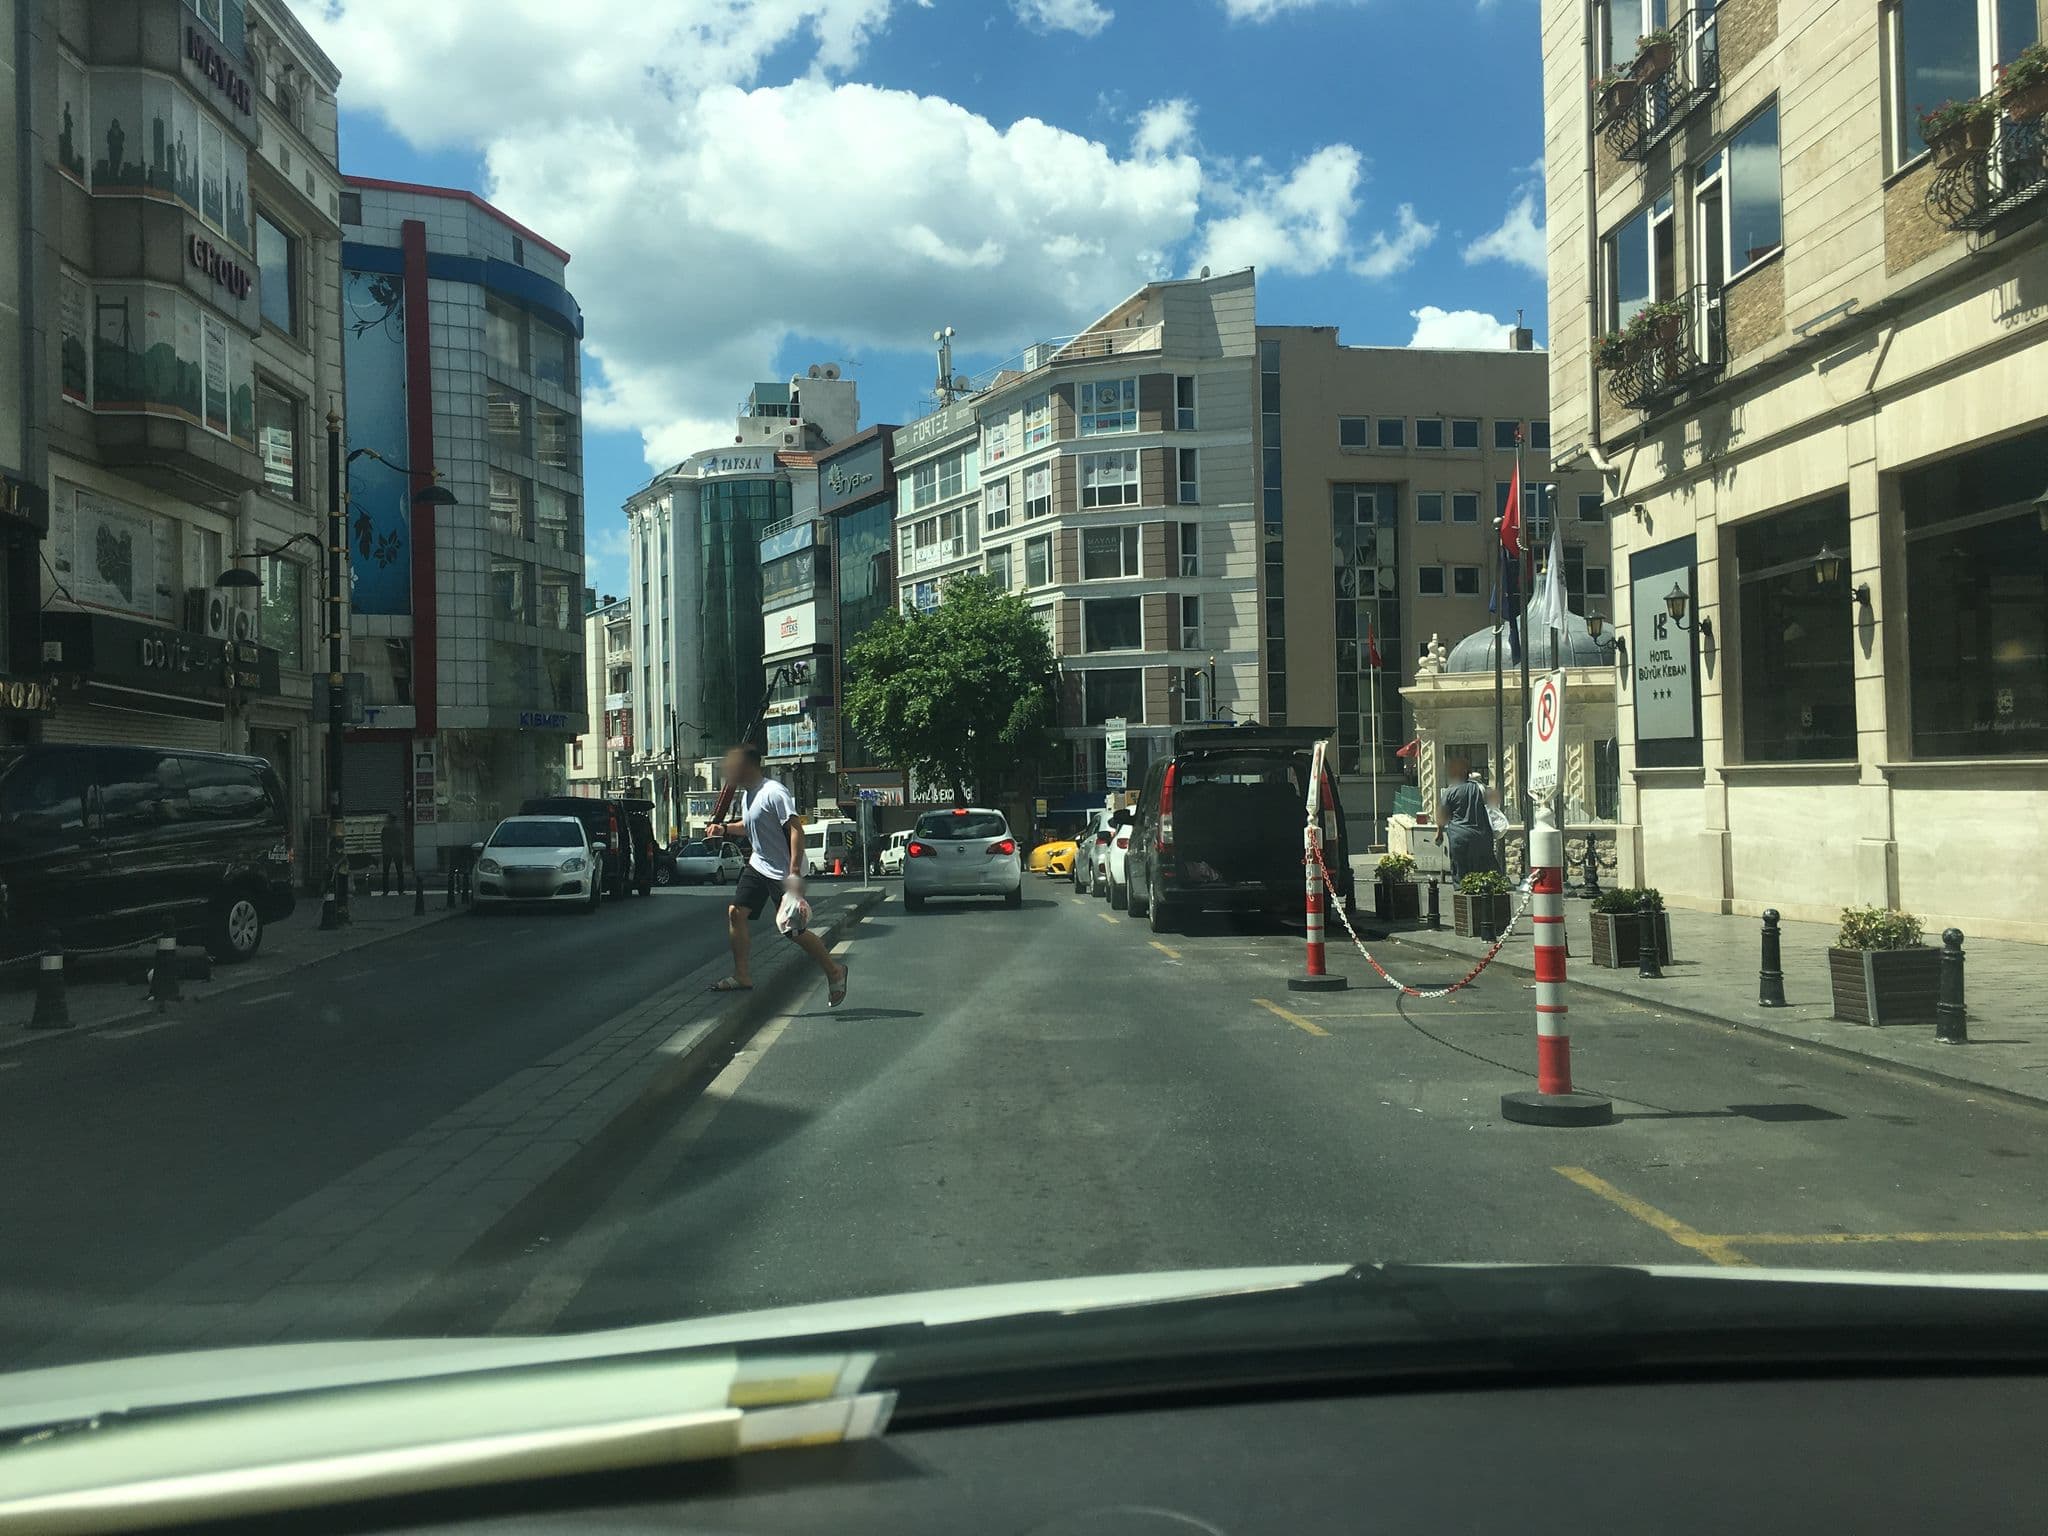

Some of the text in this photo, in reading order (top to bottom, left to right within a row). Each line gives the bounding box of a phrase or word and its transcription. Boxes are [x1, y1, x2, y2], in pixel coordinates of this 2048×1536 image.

[189, 233, 250, 300] GROUP
[721, 457, 762, 471] TAYSAN
[1649, 649, 1673, 663] HOTEL
[1638, 664, 1687, 681] BÜYÜK KEBAN
[519, 711, 568, 728] KISMET
[1537, 758, 1552, 772] PARK
